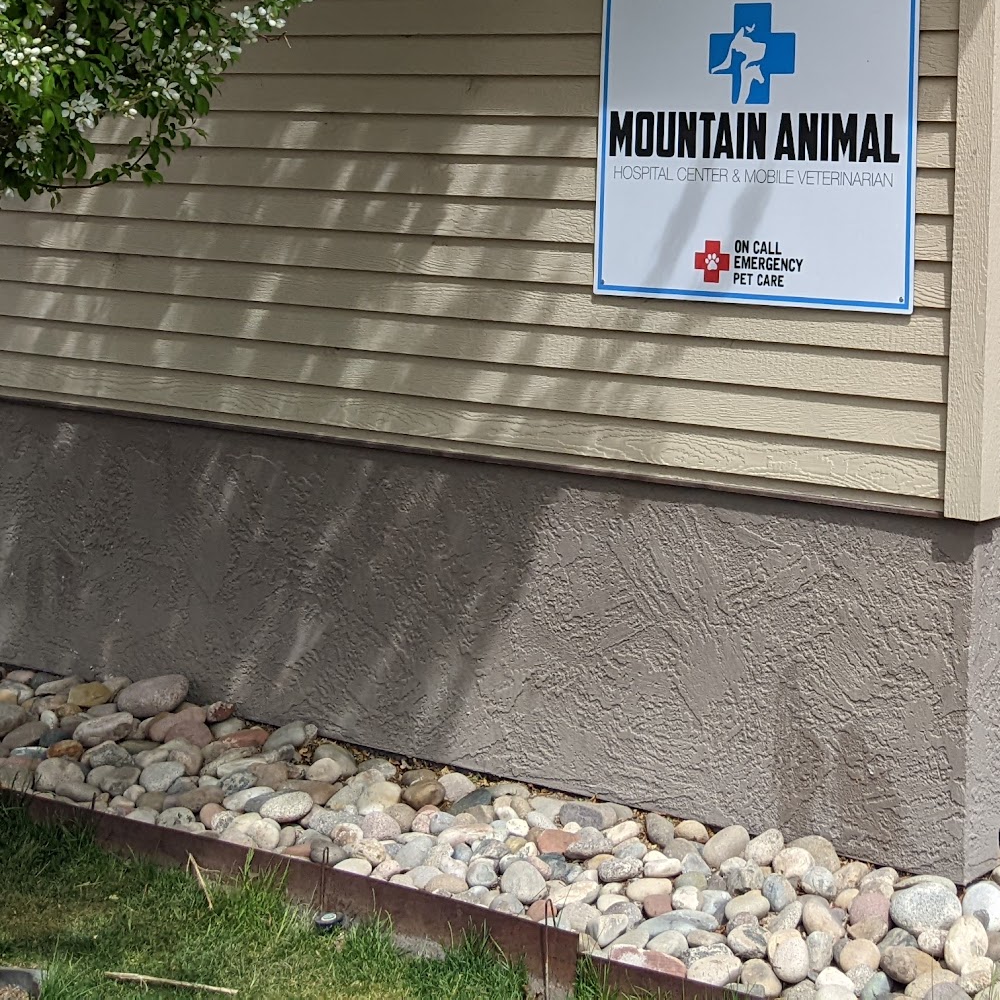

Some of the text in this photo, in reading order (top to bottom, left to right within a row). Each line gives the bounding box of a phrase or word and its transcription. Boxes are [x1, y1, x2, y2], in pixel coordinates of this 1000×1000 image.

[609, 110, 900, 163] MOUNTAIN ANIMAL
[613, 165, 894, 188] HOSPITAL CENTER & MOBILE VETERINARIAN
[734, 239, 782, 255] ON CALL
[733, 255, 804, 272] EMERGENCY
[733, 272, 785, 288] PET CARE
